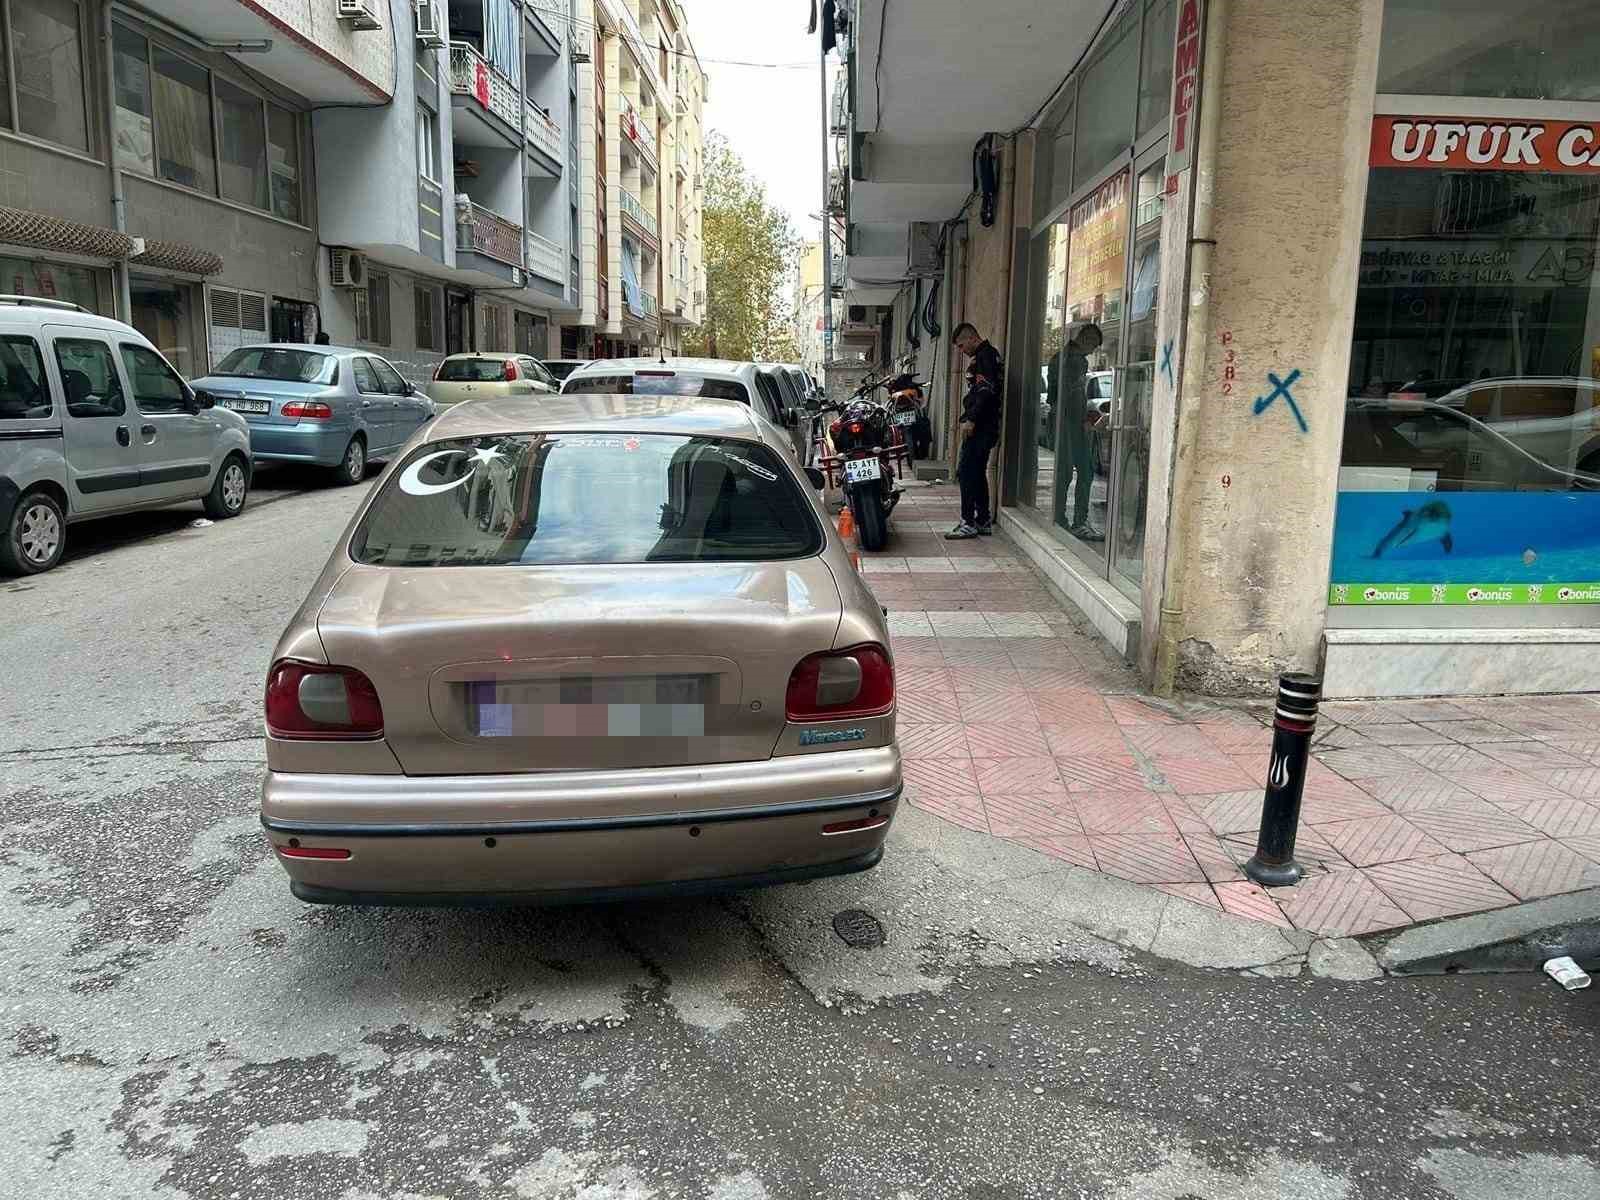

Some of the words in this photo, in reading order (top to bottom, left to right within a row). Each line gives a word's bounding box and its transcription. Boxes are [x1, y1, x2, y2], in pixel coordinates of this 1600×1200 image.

[1391, 122, 1545, 164] UFUK
[1557, 127, 1600, 167] C
[848, 462, 858, 470] 45
[857, 469, 872, 478] 426
